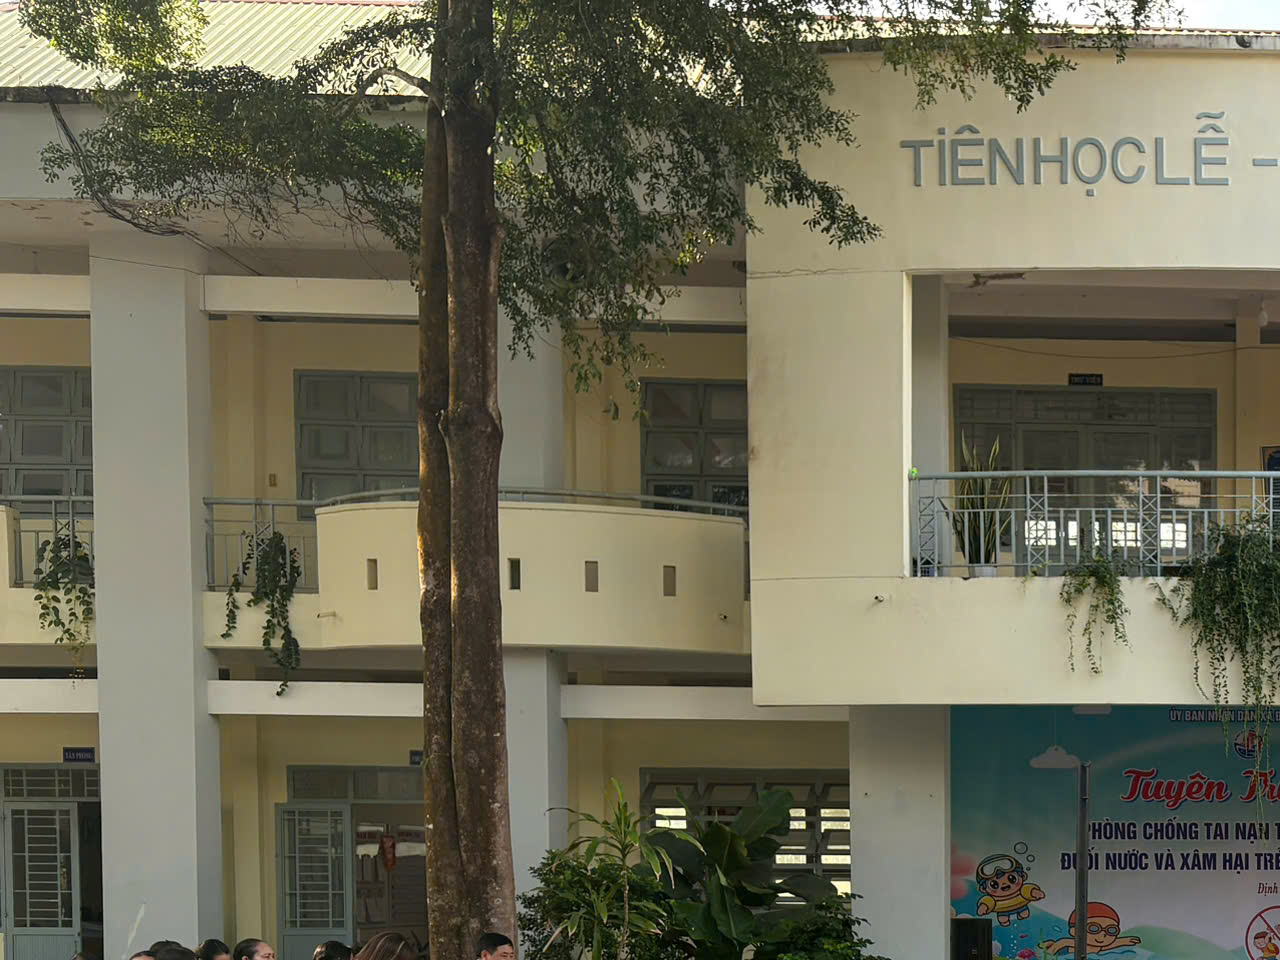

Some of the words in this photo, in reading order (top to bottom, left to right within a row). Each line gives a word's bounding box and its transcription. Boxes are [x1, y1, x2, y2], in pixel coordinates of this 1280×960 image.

[1033, 136, 1146, 197] HỌC
[1155, 112, 1230, 186] LỄ
[1185, 710, 1205, 721] BAN
[1120, 768, 1233, 811] Tuyên
[1088, 818, 1137, 840] HÒNG
[1143, 816, 1199, 840] CHỐNG
[1204, 822, 1229, 840] TAI
[1235, 822, 1270, 844] NẠN
[1105, 849, 1149, 871] NƯỚC
[1155, 849, 1176, 871] VÀ
[1180, 849, 1217, 871] XÂM
[1222, 853, 1249, 875] HẠI
[1257, 882, 1278, 897] Định
